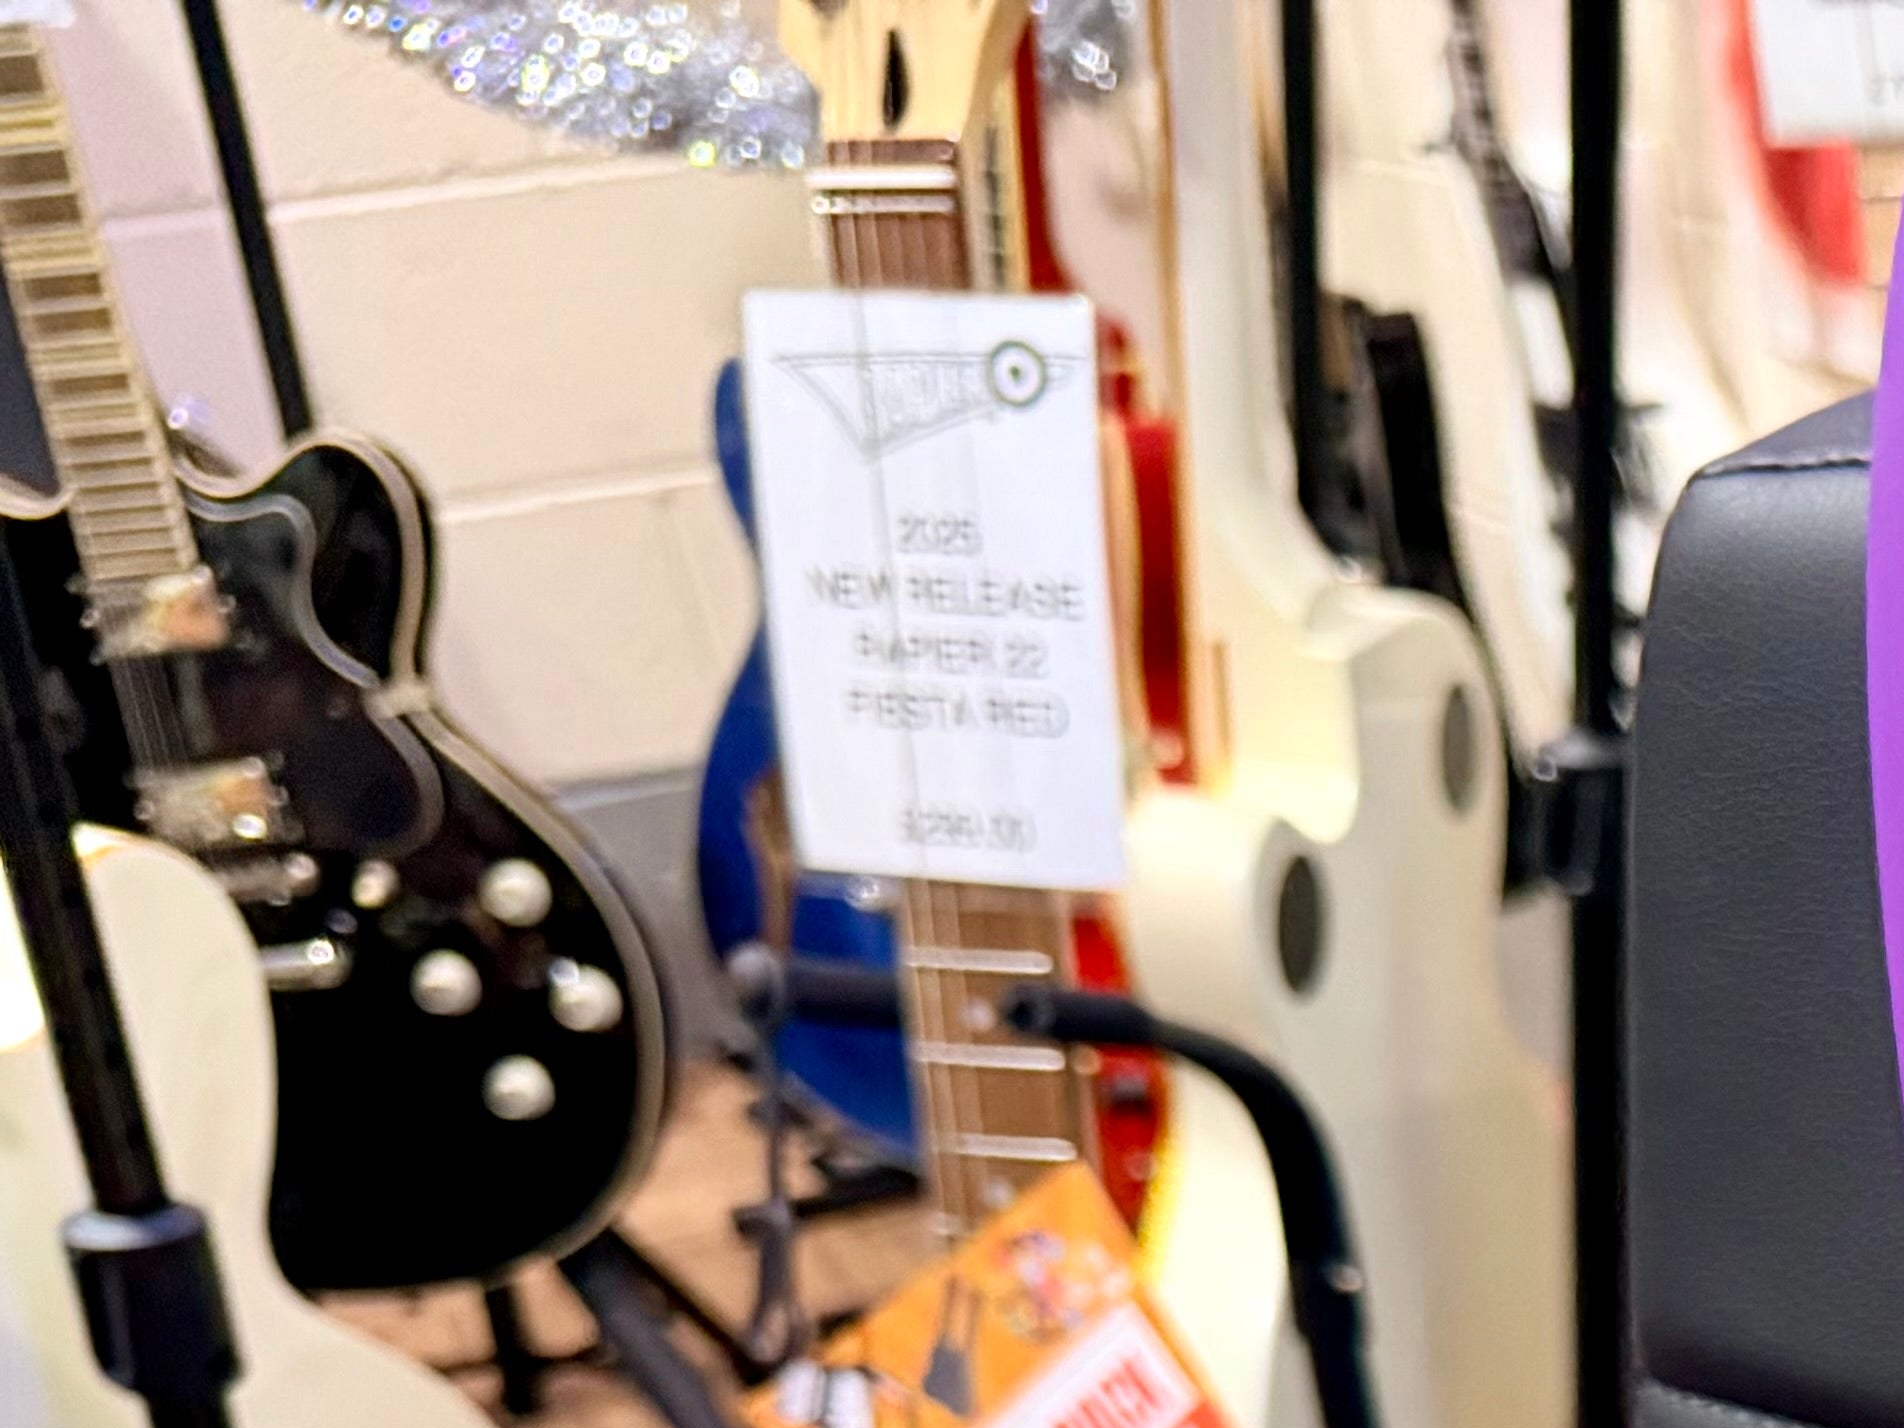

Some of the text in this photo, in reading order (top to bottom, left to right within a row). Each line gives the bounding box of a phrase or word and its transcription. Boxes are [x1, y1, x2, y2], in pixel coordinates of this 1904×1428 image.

[805, 562, 1088, 622] NEW RELEASE
[983, 694, 1071, 740] RED
